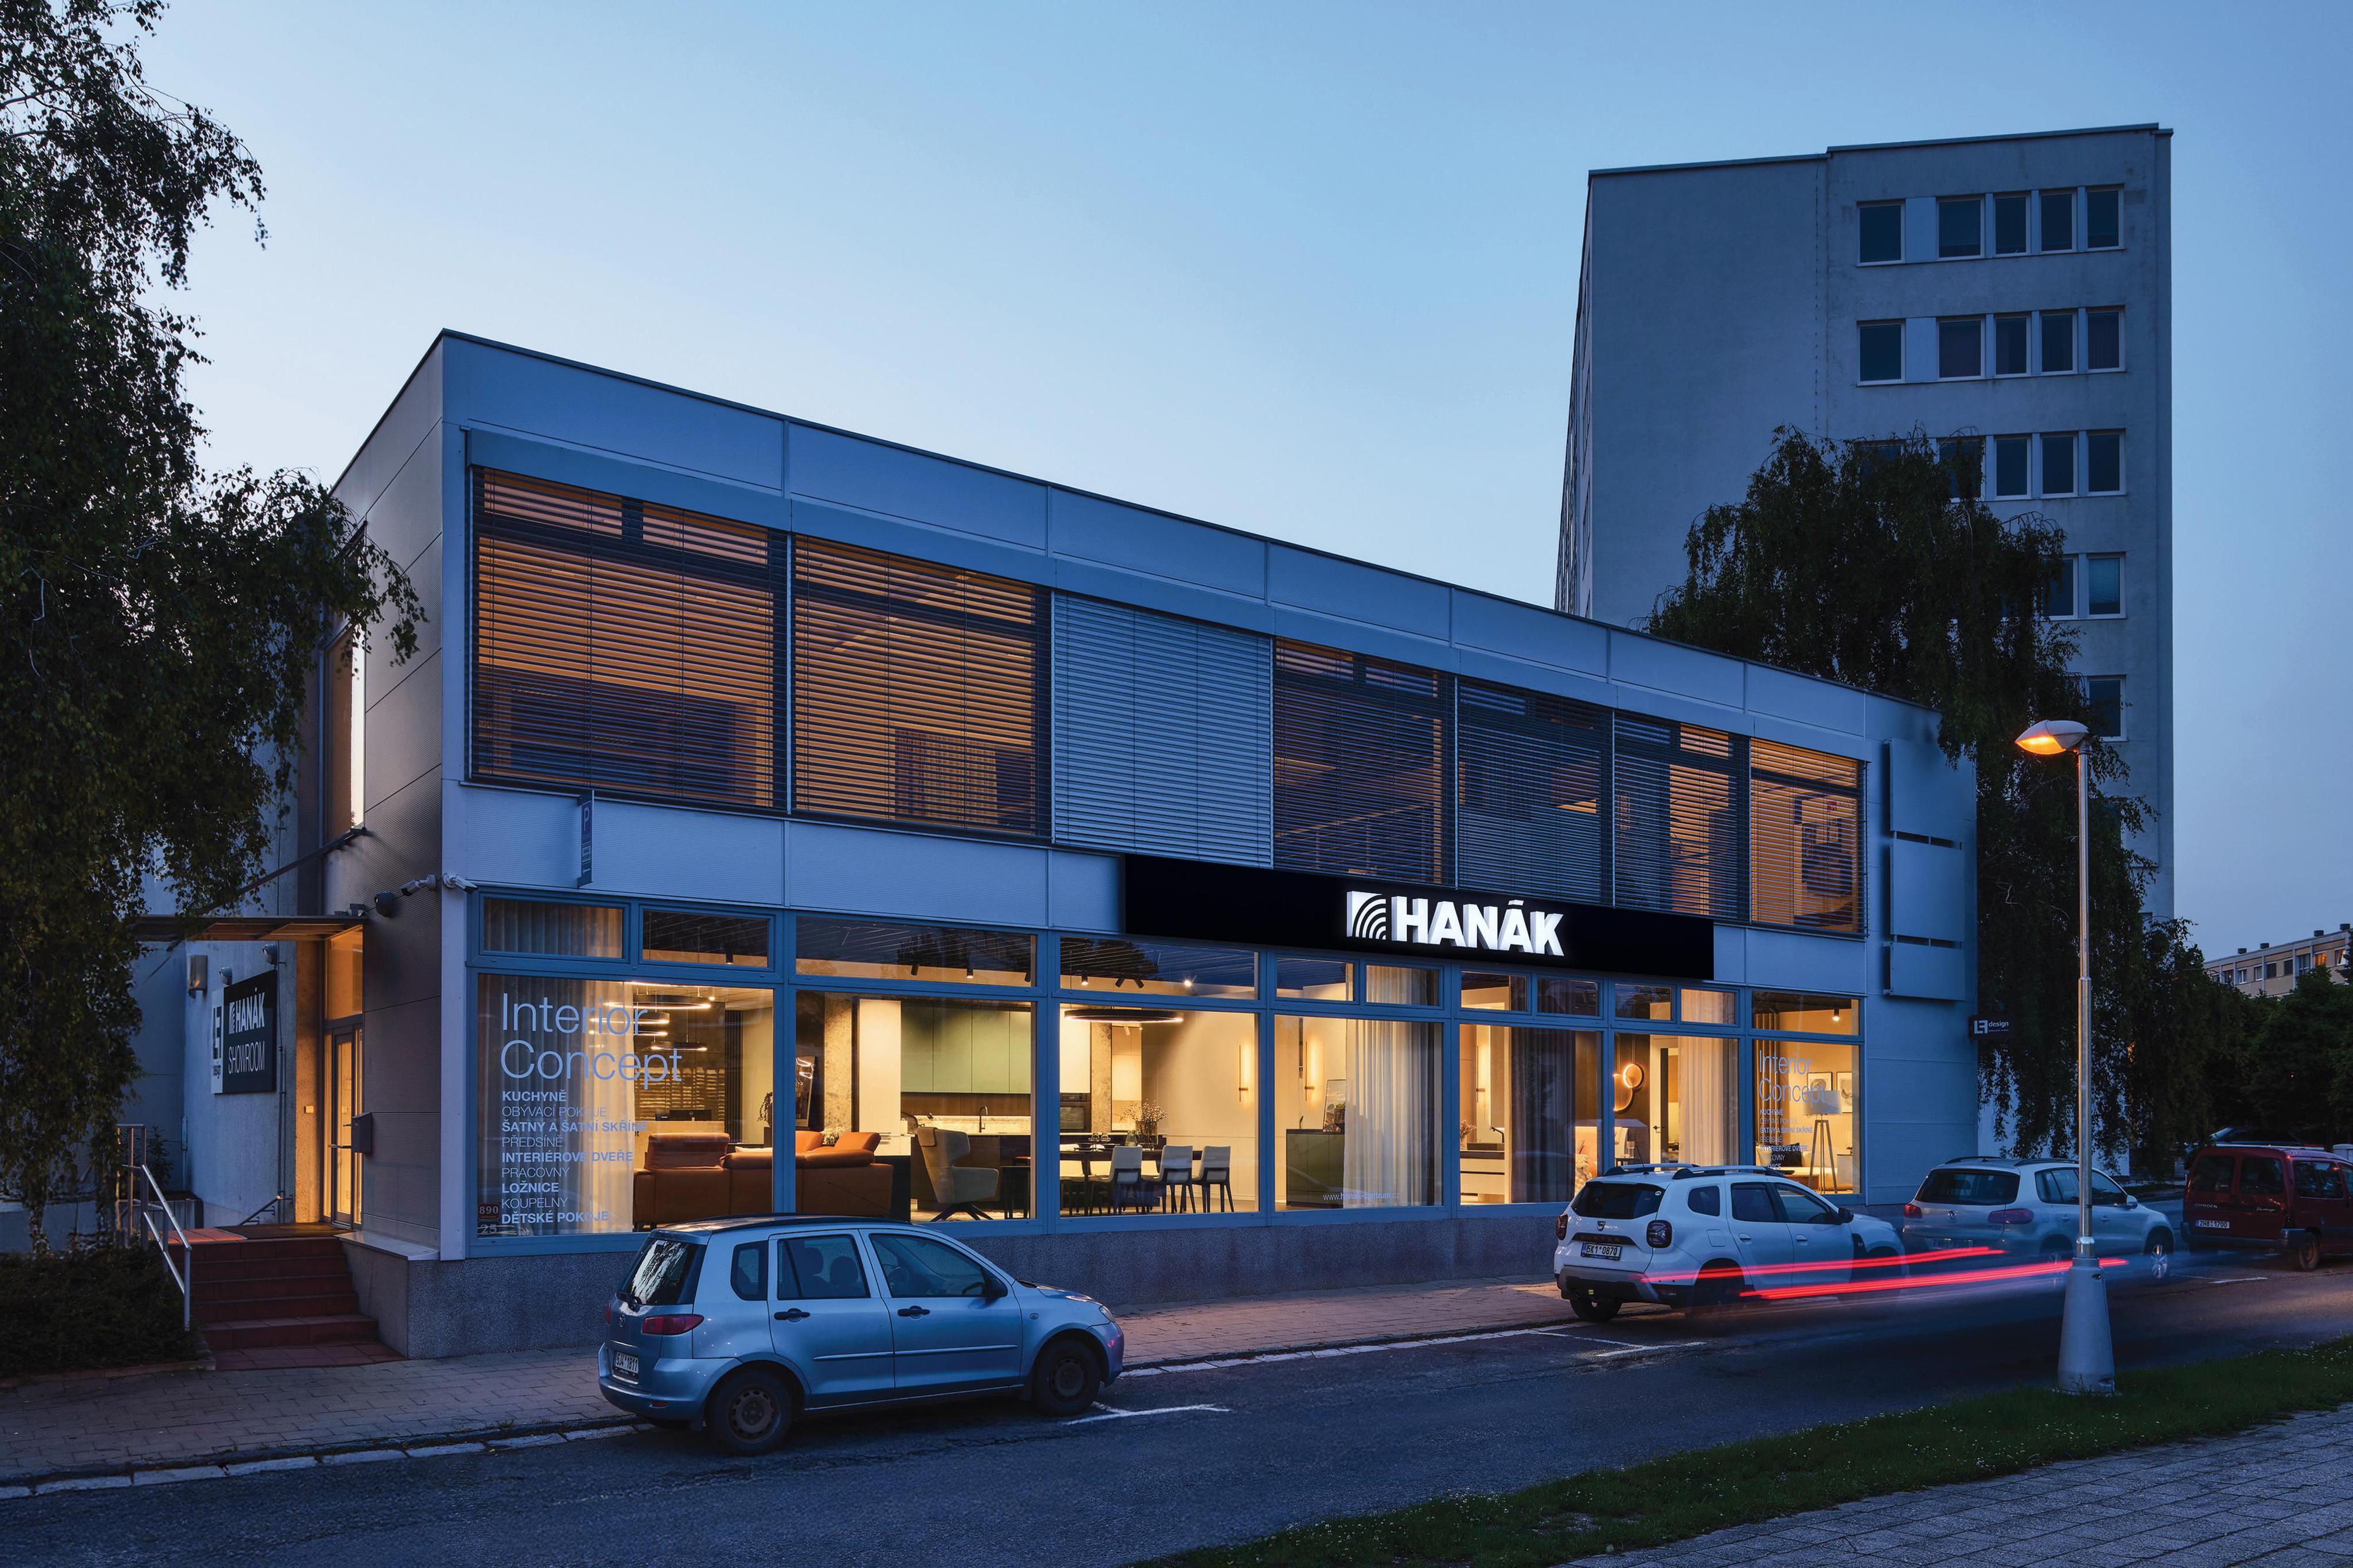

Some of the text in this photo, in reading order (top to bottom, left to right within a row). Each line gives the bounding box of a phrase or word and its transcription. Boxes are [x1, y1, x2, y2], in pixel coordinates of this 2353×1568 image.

[1391, 896, 1564, 956] HANÁK
[235, 987, 265, 1033] HANÁK
[503, 993, 648, 1035] Interior
[228, 1040, 265, 1075] SHOWROOM
[1759, 1050, 1814, 1075] Interior
[501, 1040, 682, 1090] Concept
[502, 1089, 566, 1102] KUCHYNĚ
[1759, 1077, 1826, 1108] Concept
[502, 1104, 556, 1117] OBÝVACÍ
[502, 1119, 648, 1132] ŠATNY A ŠATNÍ SKŘÍNĚ
[502, 1135, 563, 1147] PŘEDSÍNĚ
[592, 1149, 633, 1161] DVEŘE
[502, 1167, 570, 1177] PRACOVNY
[502, 1180, 559, 1193] LOŽNICE
[502, 1197, 568, 1209] KOUPELNY
[479, 1206, 499, 1215] 890
[502, 1210, 609, 1224] DĚTSKÉ POKOJE
